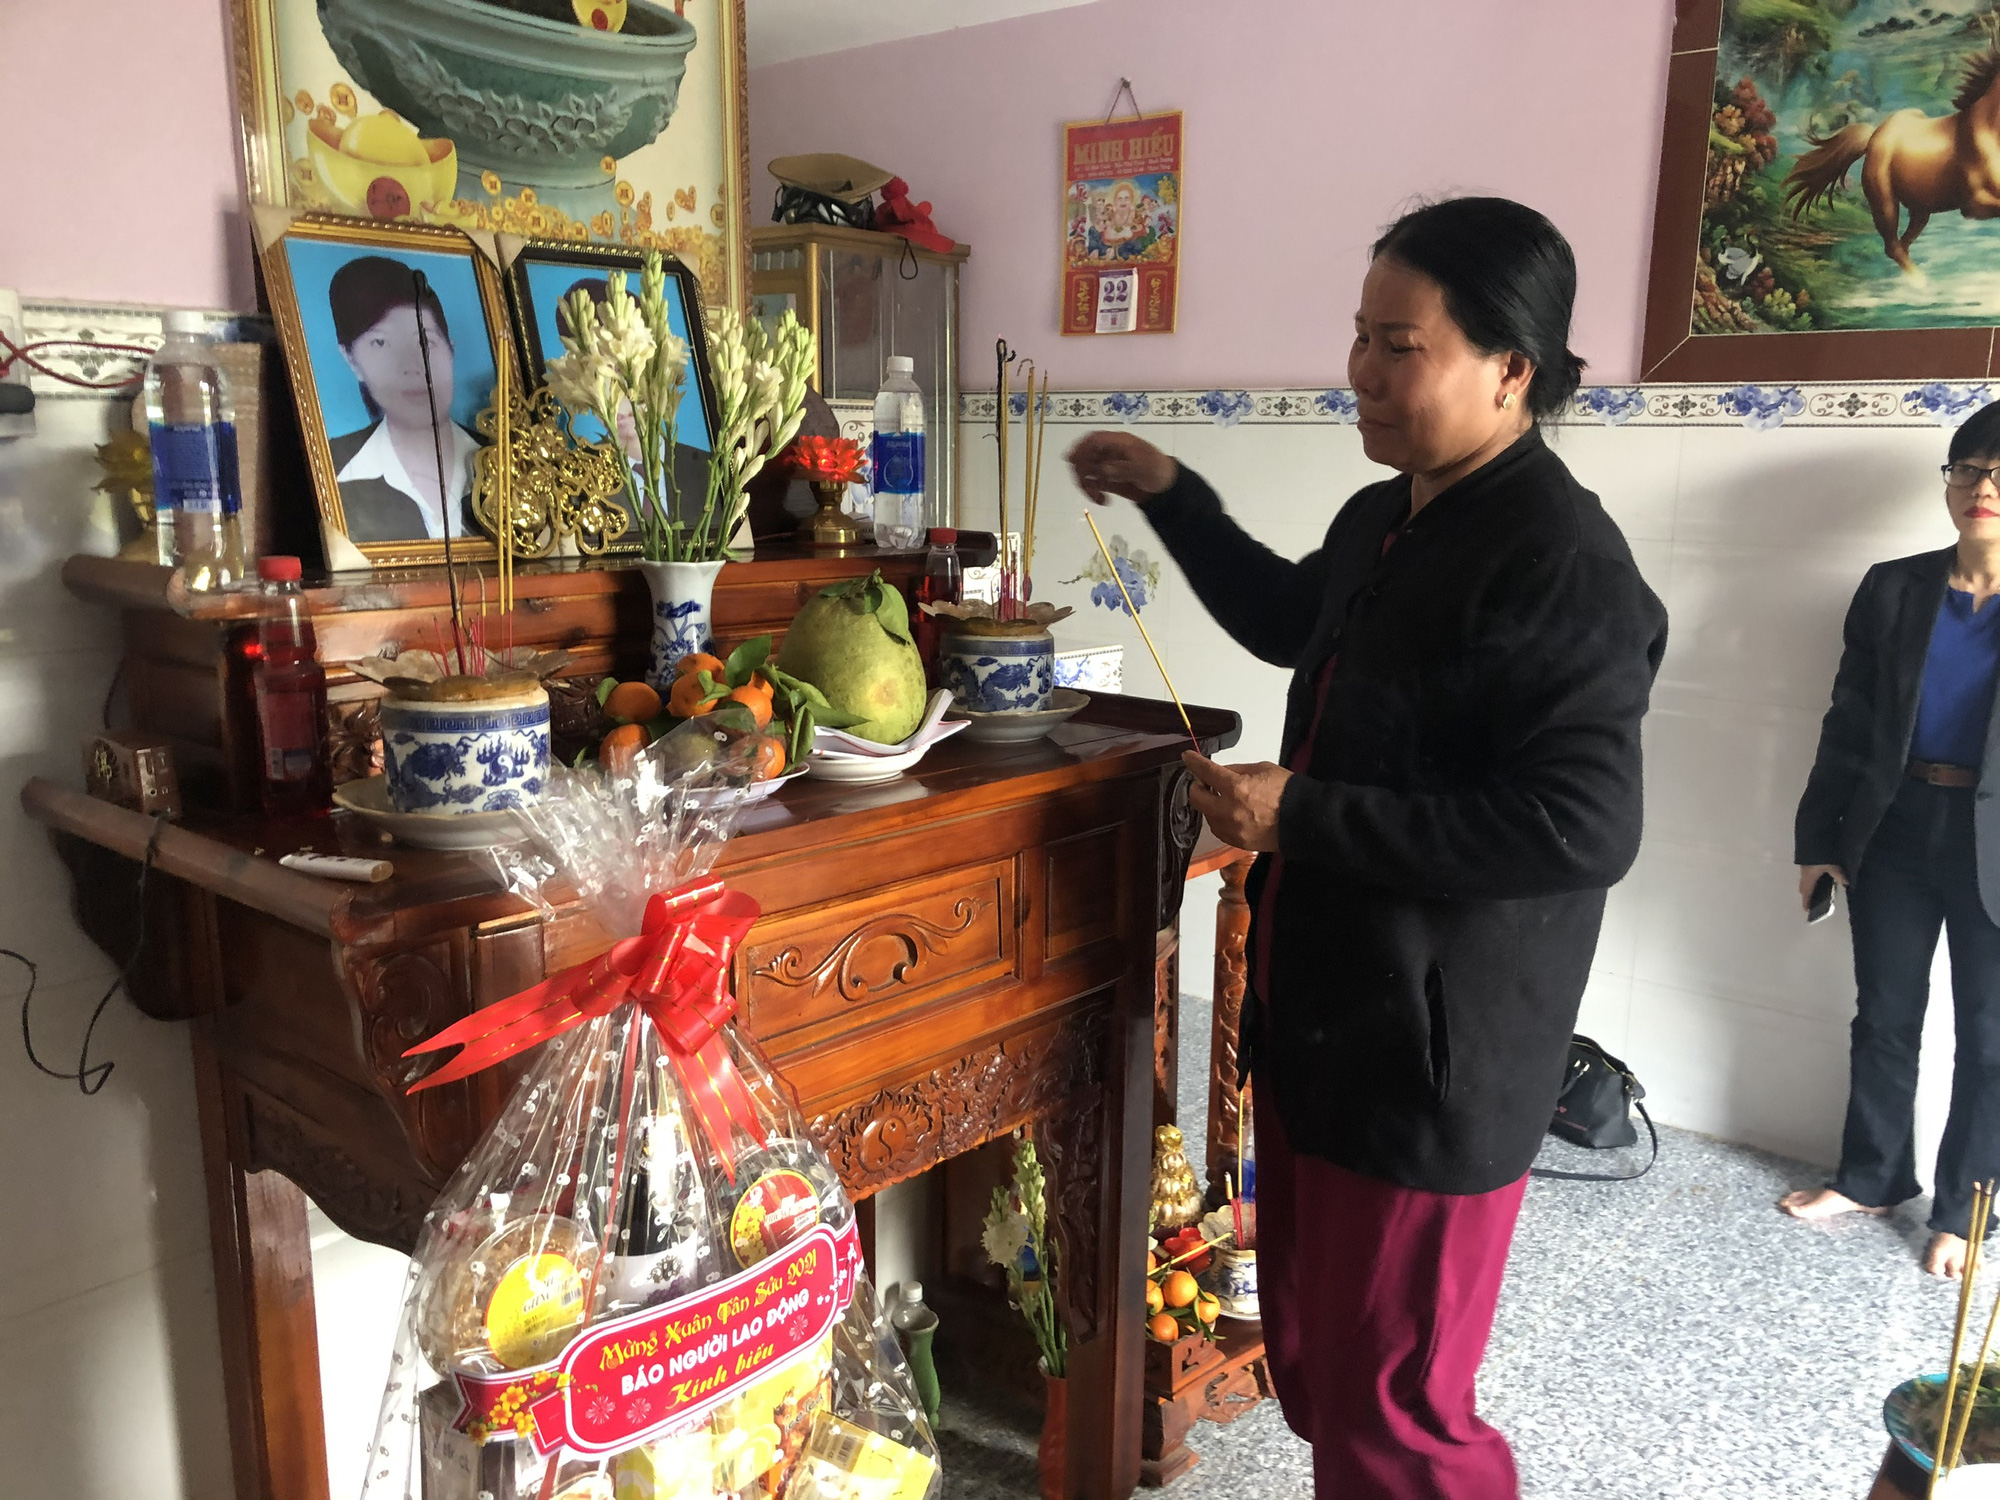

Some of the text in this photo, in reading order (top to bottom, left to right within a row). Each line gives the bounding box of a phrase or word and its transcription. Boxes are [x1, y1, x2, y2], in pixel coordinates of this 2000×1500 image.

[1073, 139, 1124, 166] MINH
[1128, 126, 1175, 160] HIẾU
[1103, 279, 1128, 303] 22
[600, 1330, 659, 1371] Mừng
[665, 1314, 712, 1349] Xuân
[717, 1294, 749, 1325] Tân
[787, 1249, 817, 1286] 2021
[621, 1288, 810, 1396] BÁO NGƯỜI LAO ĐỘNG
[735, 1341, 774, 1376] biếu
